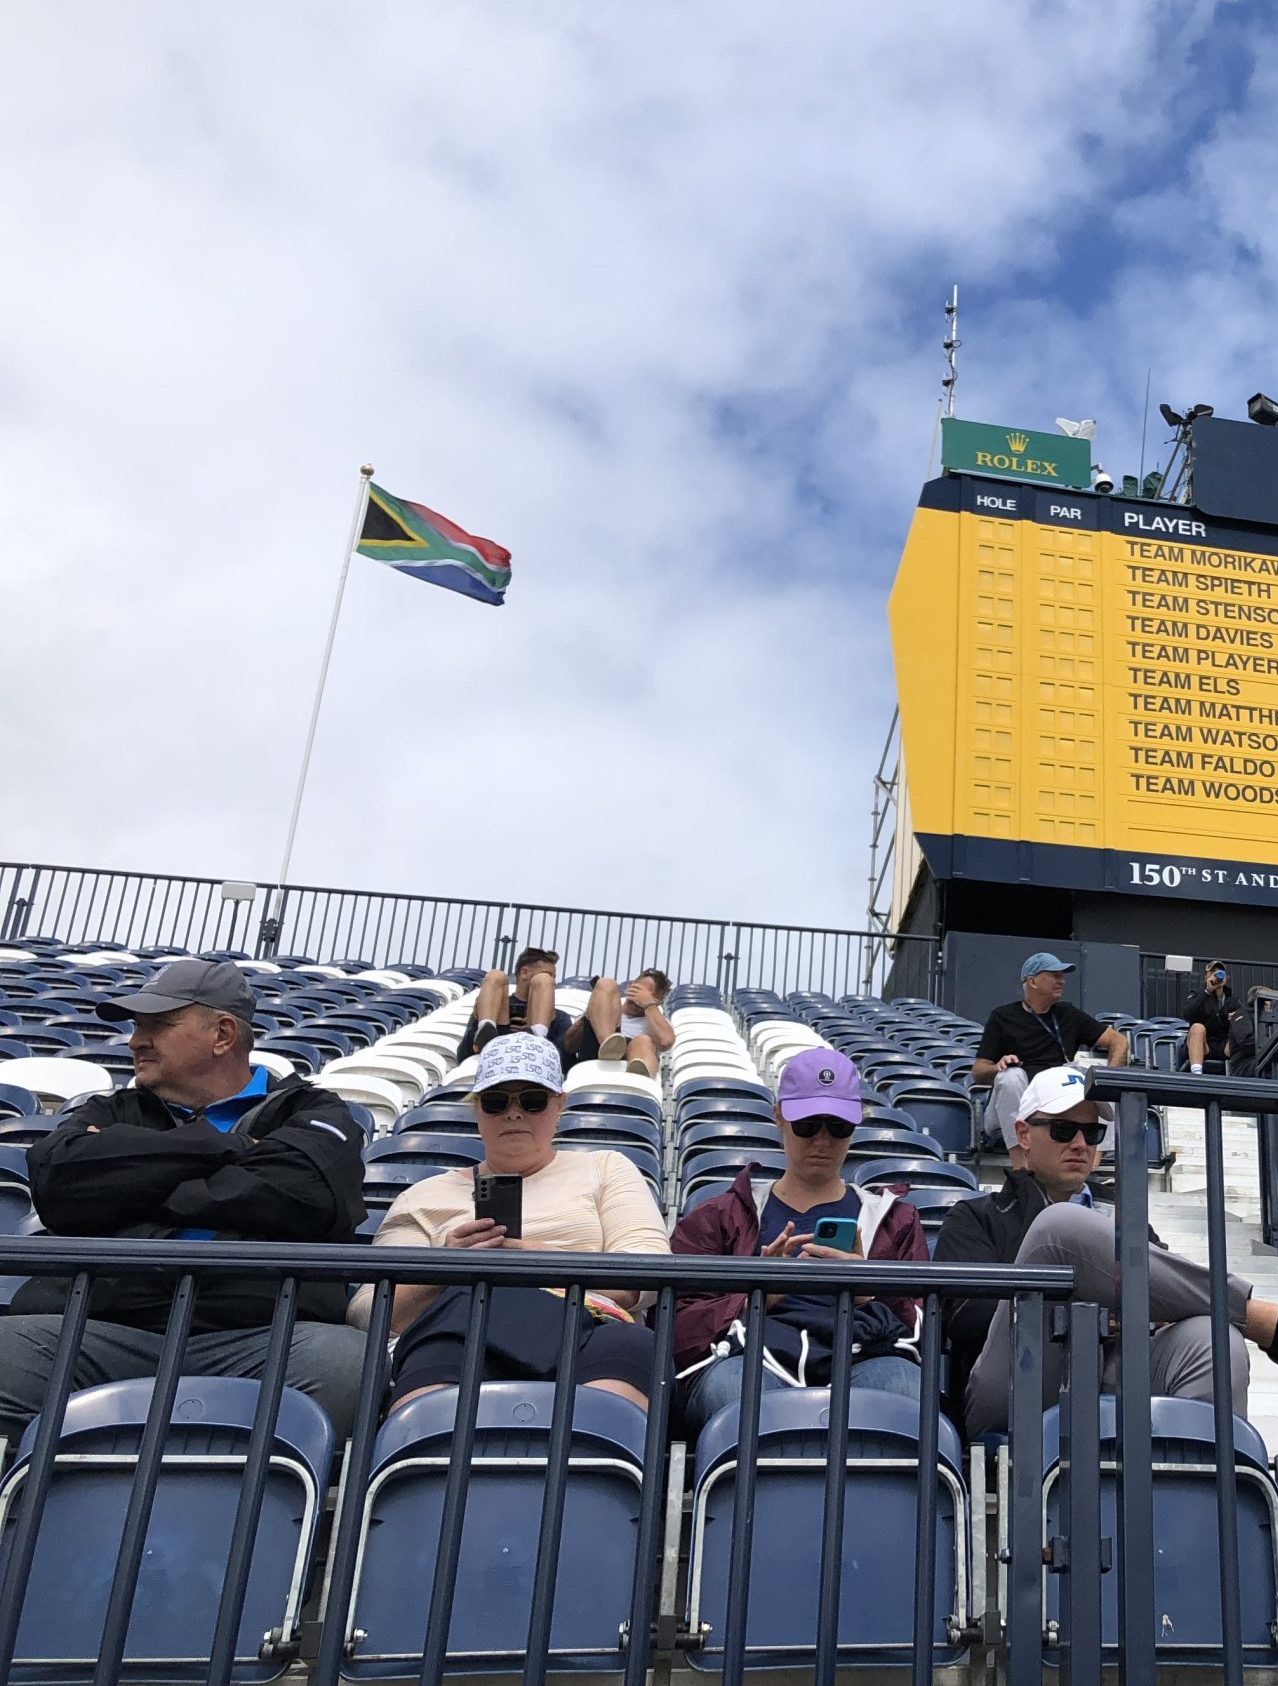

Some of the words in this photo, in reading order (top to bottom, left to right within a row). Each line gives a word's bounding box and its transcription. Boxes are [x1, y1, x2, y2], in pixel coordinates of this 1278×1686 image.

[975, 451, 1059, 477] ROLEX
[976, 494, 1016, 511] HOLE
[1050, 505, 1082, 520] PAR
[1124, 512, 1207, 538] PLAYER
[1126, 540, 1184, 563] TEAM
[1126, 565, 1189, 588] TEAM
[1195, 574, 1272, 600] SPIETH
[1126, 590, 1189, 614] TEAM
[1126, 615, 1189, 639] TEAM
[1195, 624, 1274, 650] DAVIES
[1126, 641, 1190, 665] TEAM
[1128, 666, 1191, 690] TEAM
[1199, 675, 1241, 696] ELS
[1128, 692, 1192, 716] TEAM
[1129, 720, 1193, 743] TEAM
[1129, 746, 1194, 769] TEAM
[1201, 753, 1276, 778] FALDO
[1130, 773, 1196, 797] TEAM
[1129, 862, 1196, 888] 150TH
[1202, 869, 1228, 884] ST
